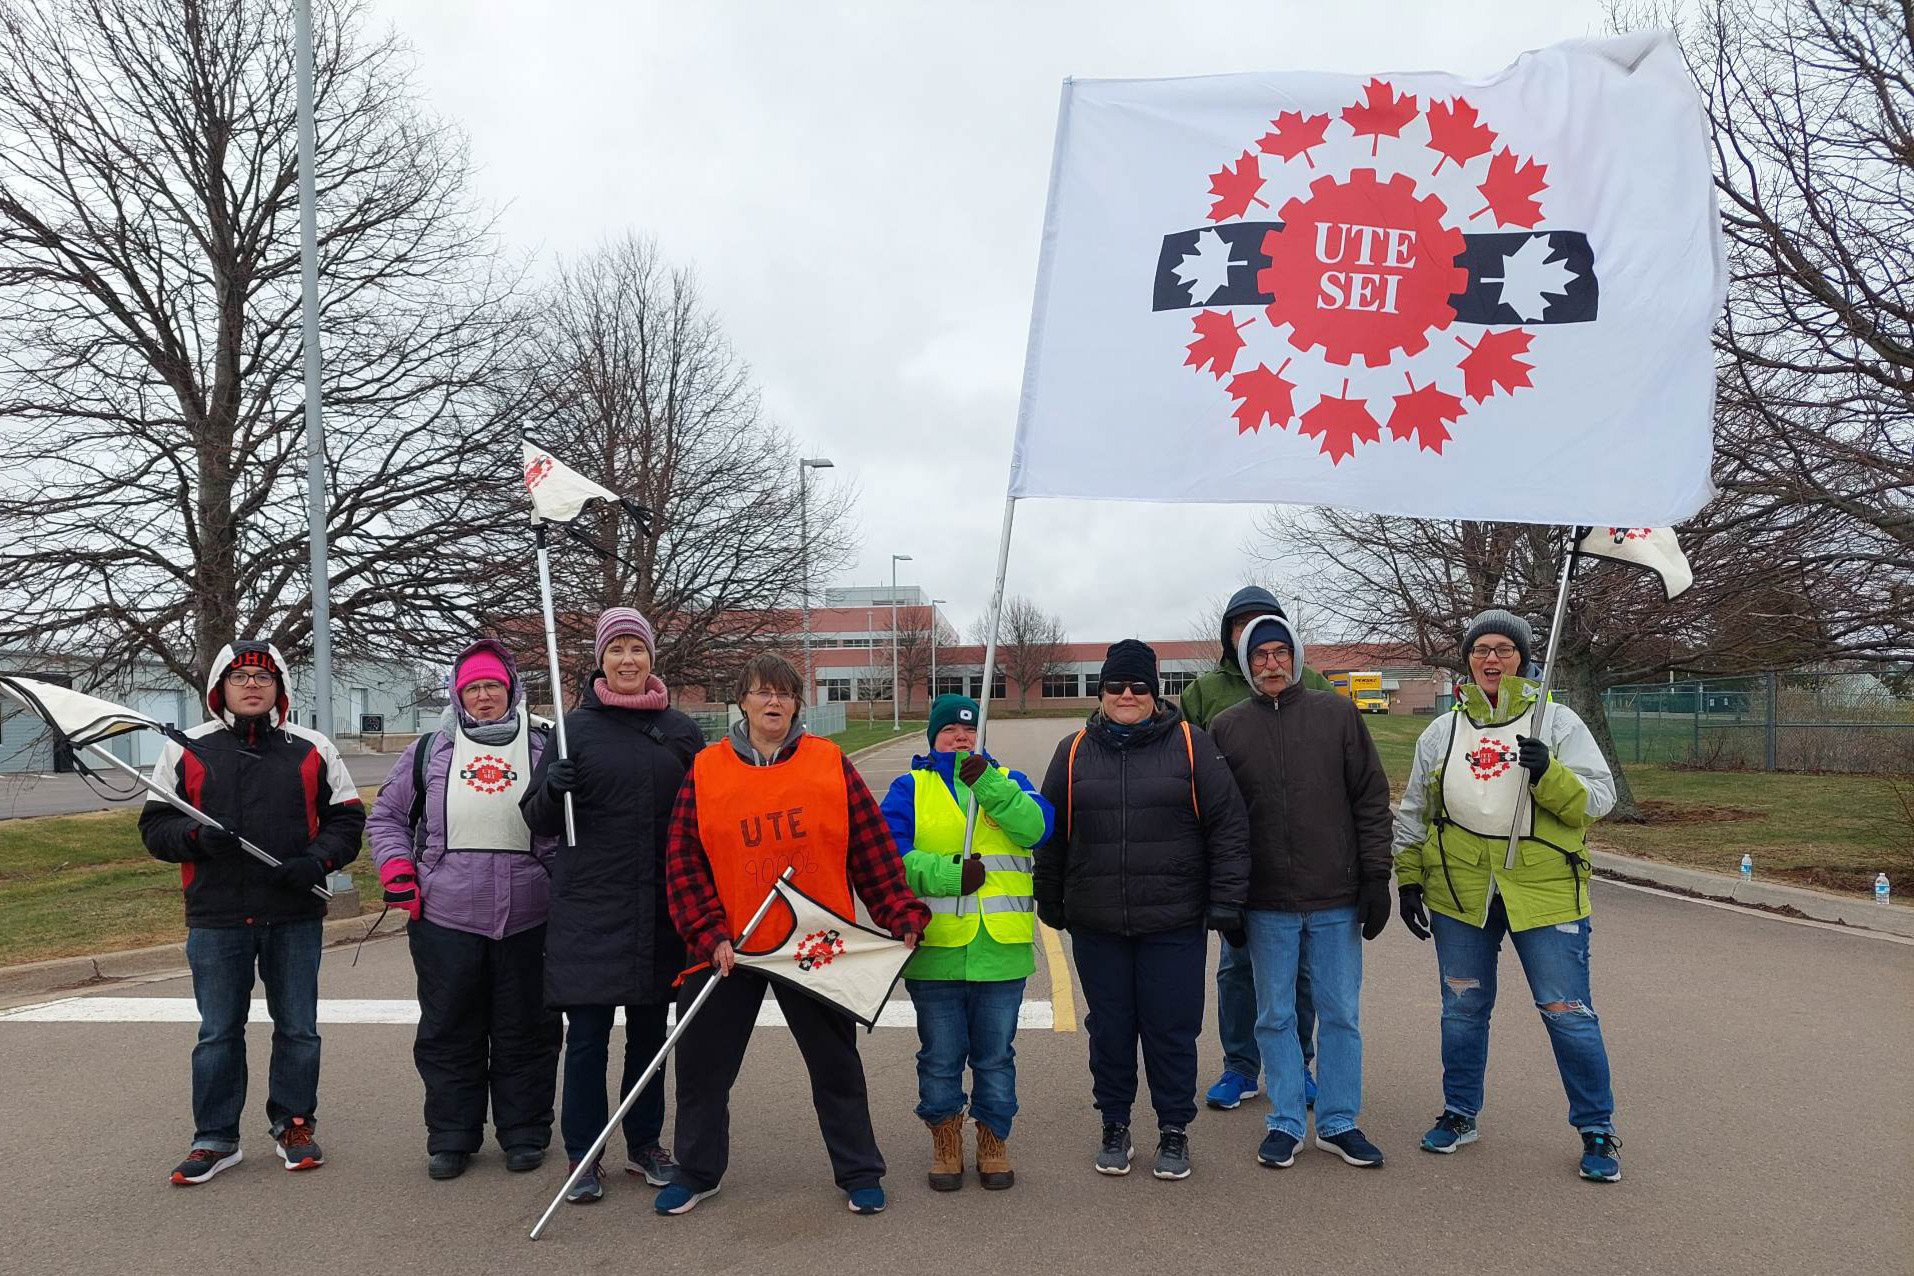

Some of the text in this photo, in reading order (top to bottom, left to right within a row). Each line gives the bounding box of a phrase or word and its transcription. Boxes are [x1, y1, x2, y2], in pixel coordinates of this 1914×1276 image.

[1314, 222, 1416, 269] UTE
[1317, 271, 1403, 314] SEI
[740, 807, 806, 848] UTE
